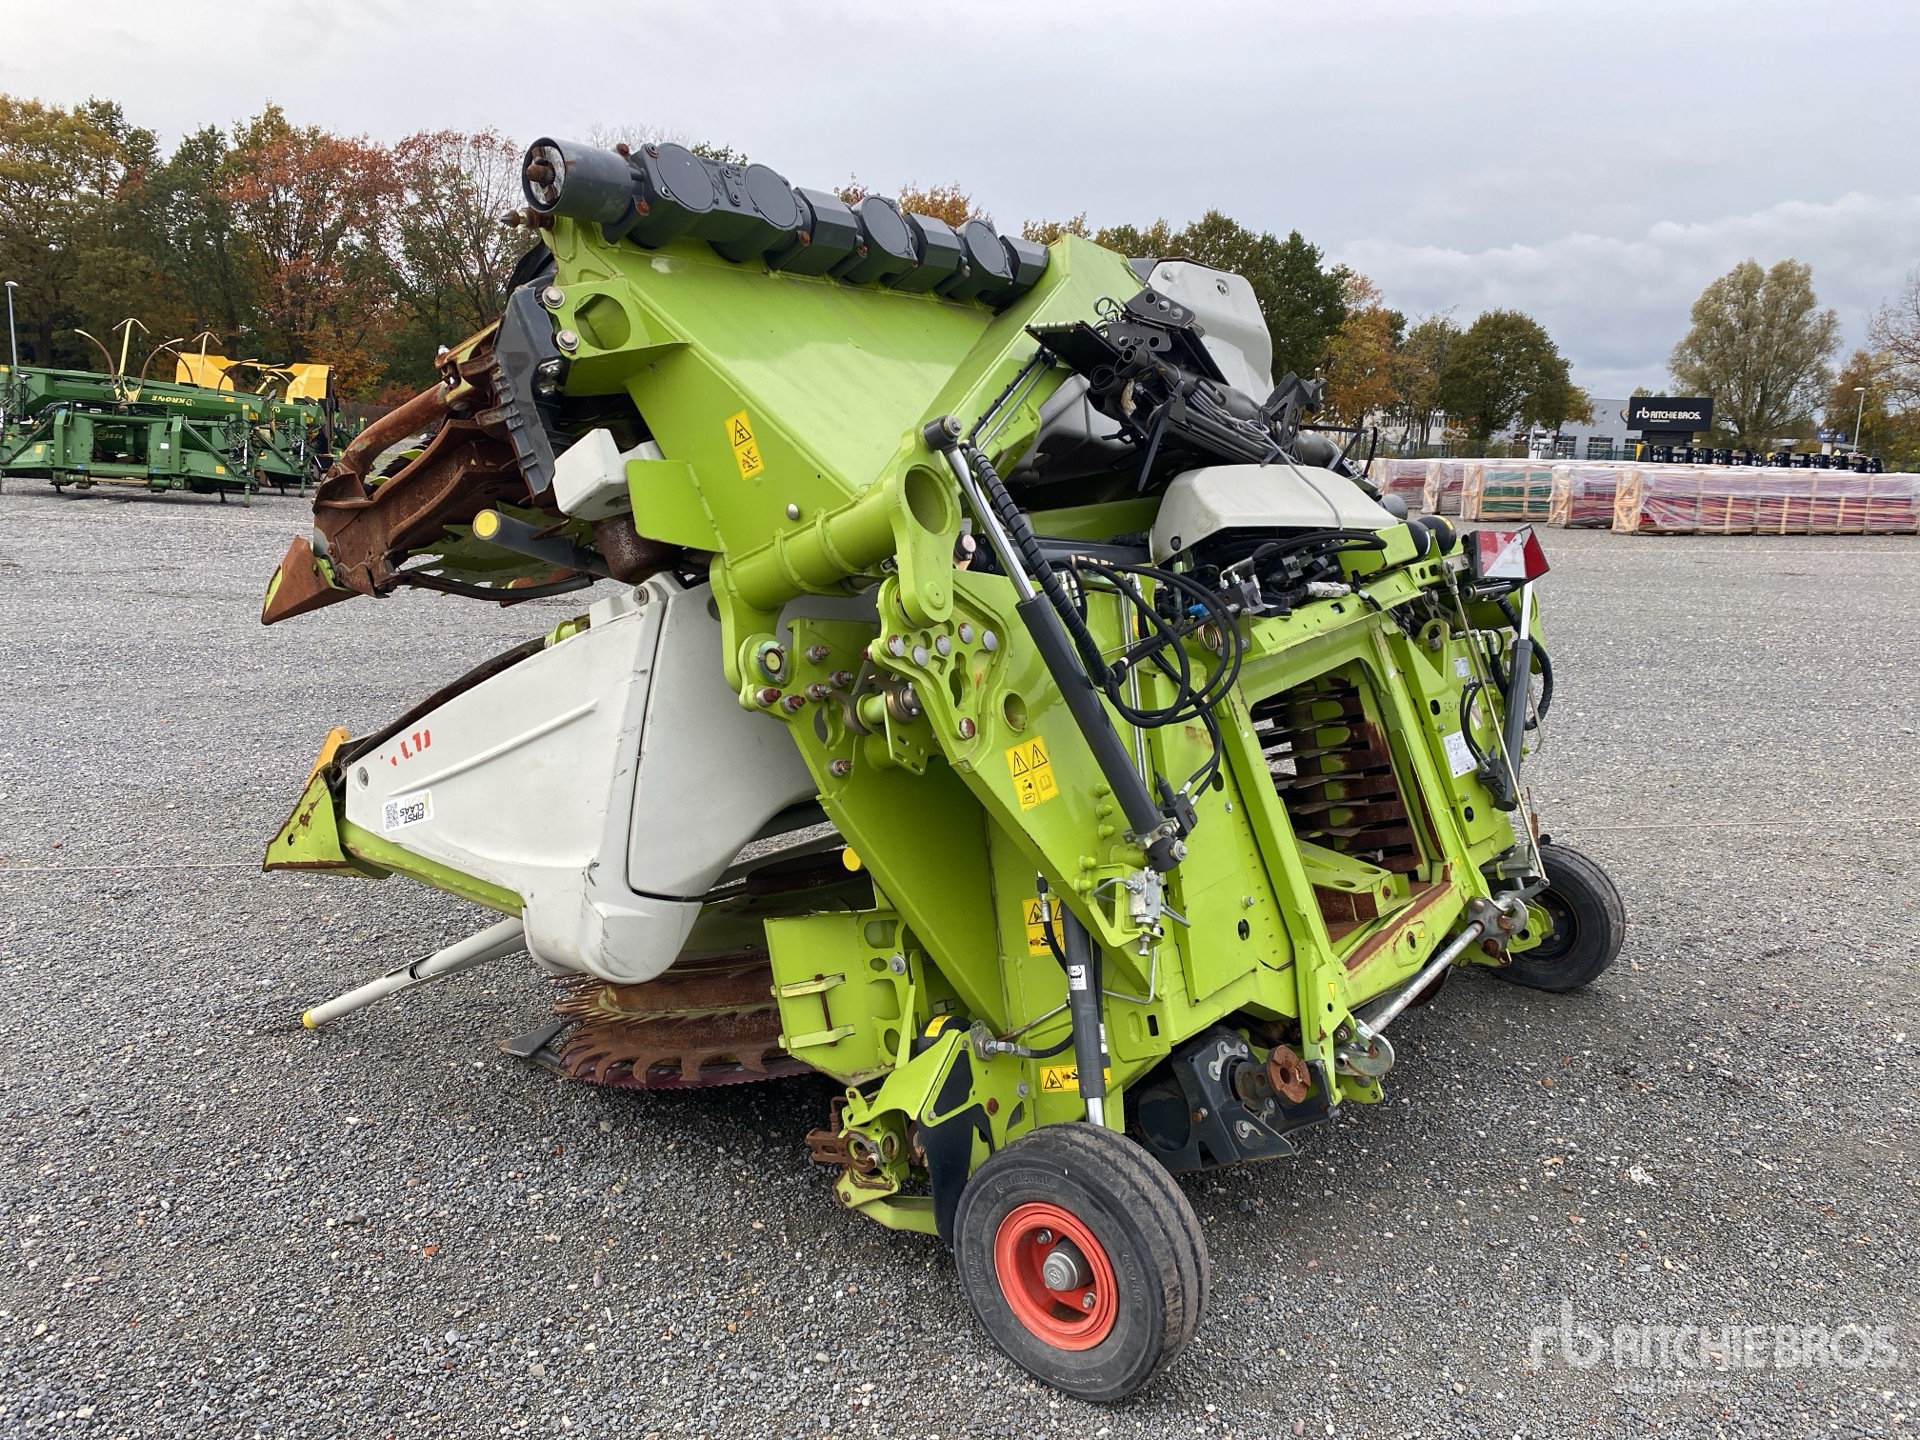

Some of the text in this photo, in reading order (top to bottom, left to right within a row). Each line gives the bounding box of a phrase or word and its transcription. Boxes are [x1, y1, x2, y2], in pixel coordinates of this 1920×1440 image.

[151, 395, 186, 404] KRONE
[1650, 410, 1677, 419] RITCHIE
[1677, 411, 1702, 420] BROS.
[399, 802, 425, 818] CLAAS
[403, 810, 425, 825] FIRST
